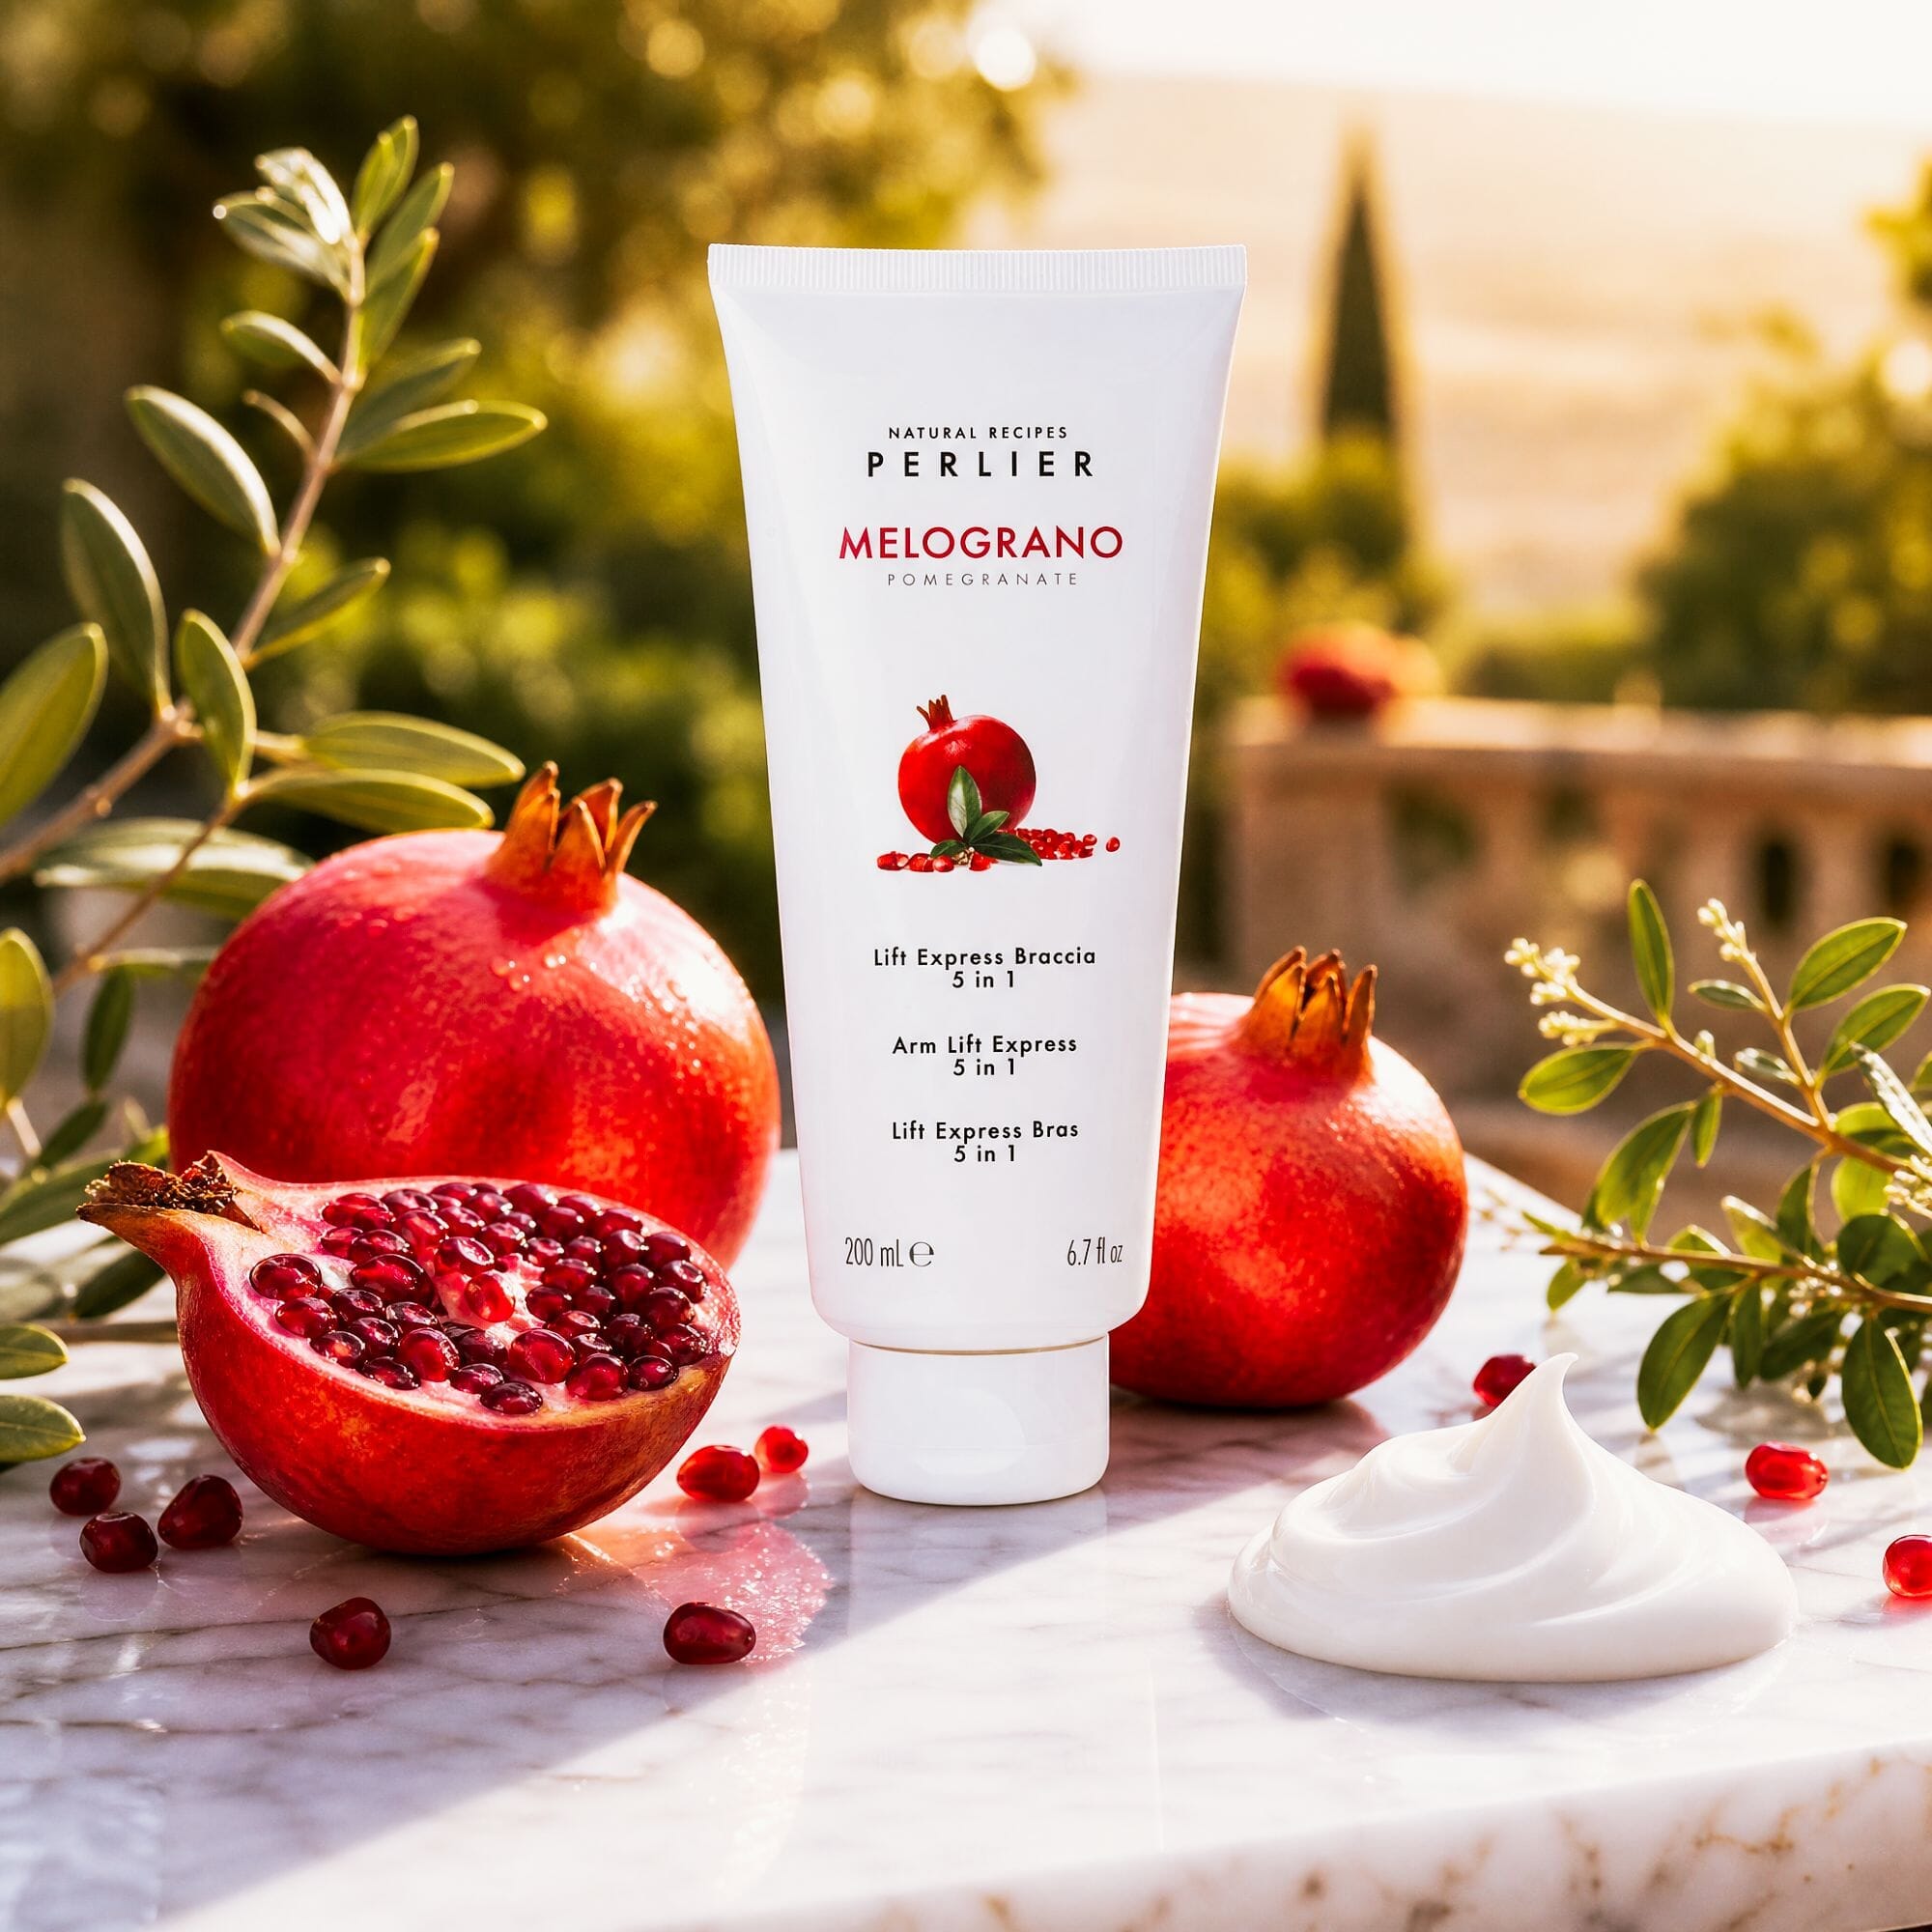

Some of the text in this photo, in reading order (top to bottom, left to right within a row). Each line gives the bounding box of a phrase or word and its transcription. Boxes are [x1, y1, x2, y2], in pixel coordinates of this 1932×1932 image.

[889, 427, 1066, 439] NATURAL RECIPES
[867, 451, 1093, 477] PERLIER
[838, 526, 1122, 559] MELOGRANO
[889, 573, 1076, 585] POMEGRANATE
[874, 946, 1094, 971] Lift Express Braccia
[952, 970, 1013, 988] 5 in 1
[892, 1034, 1077, 1058] Arm Lift Express
[953, 1058, 1013, 1076] 5 in 1
[893, 1120, 1078, 1145] Lift Express Bras
[953, 1144, 1014, 1162] 5 in 1
[845, 1237, 873, 1266] 200
[880, 1238, 904, 1267] mL
[1067, 1236, 1122, 1266] 6.7 fl oz
